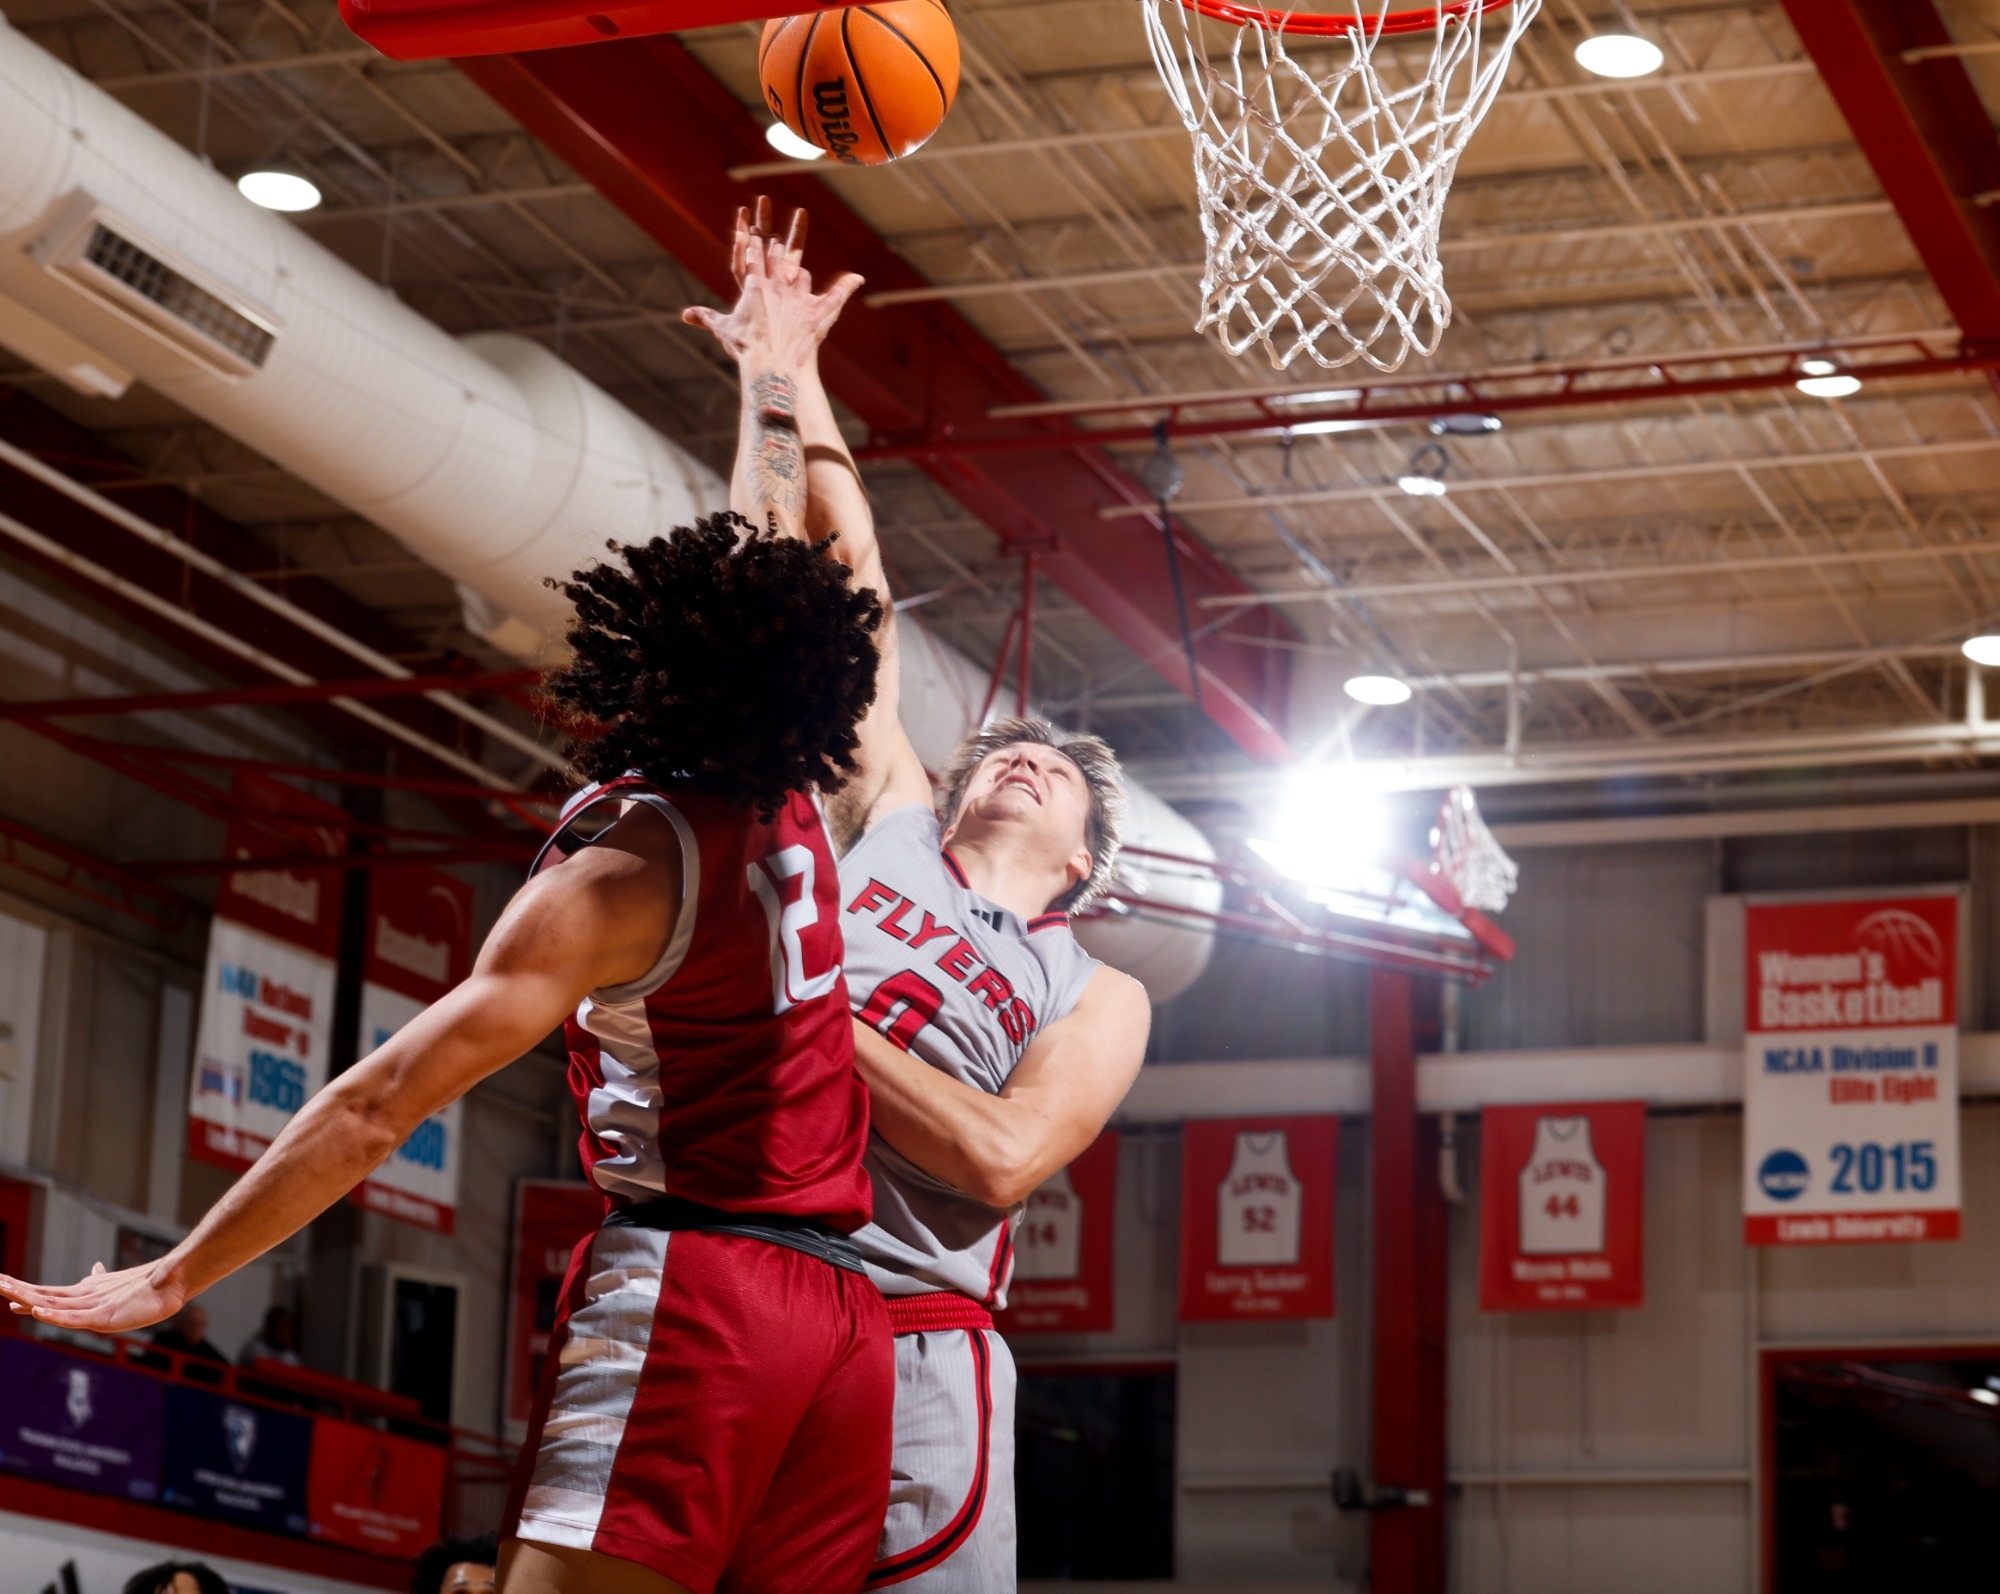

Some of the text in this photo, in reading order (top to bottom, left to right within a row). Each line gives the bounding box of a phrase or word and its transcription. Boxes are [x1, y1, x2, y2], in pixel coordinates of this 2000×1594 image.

[746, 844, 842, 1016] 12
[846, 877, 1037, 1046] FLYERS
[1759, 949, 1885, 984] Women's
[1760, 980, 1941, 1027] Basketball
[1764, 1046, 1823, 1073] NCAA
[1830, 1043, 1916, 1072] Division
[1829, 1075, 1938, 1105] Elite Eight
[1532, 1159, 1593, 1184] LEWIS
[1830, 1140, 1936, 1194] 2015
[1231, 1172, 1289, 1197] LEWIS
[1242, 1204, 1276, 1233] 52
[1543, 1191, 1581, 1219] 44
[1026, 1220, 1057, 1247] 14
